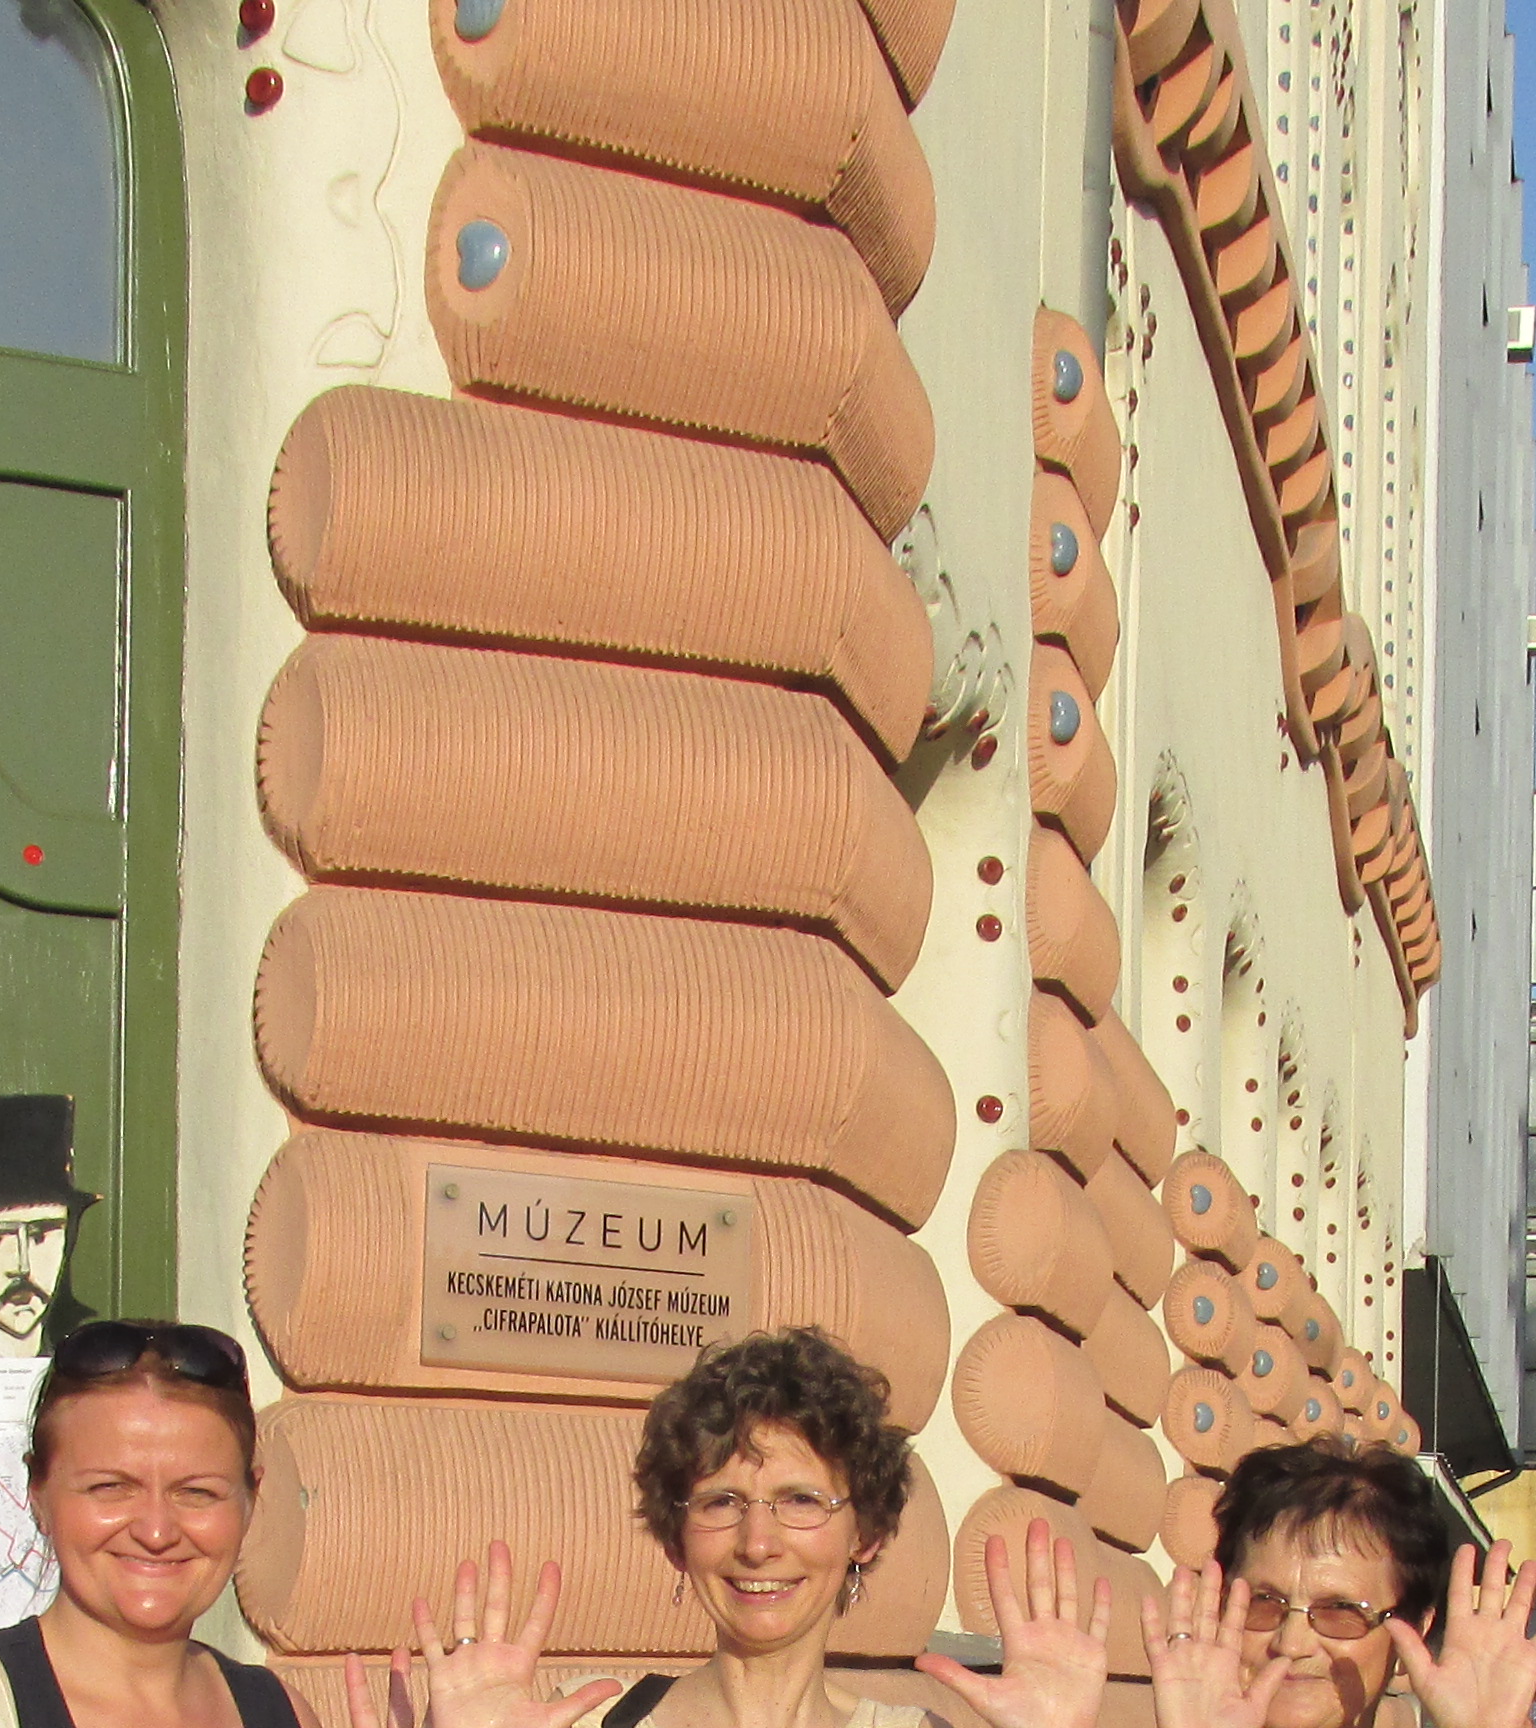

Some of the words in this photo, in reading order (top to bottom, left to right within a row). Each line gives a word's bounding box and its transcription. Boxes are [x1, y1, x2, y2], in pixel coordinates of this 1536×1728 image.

[478, 1198, 707, 1257] MÚZEUM
[447, 1271, 540, 1301] KECSKEMÉTI
[545, 1279, 603, 1307] KATONA
[608, 1280, 662, 1311] JÓZSEF
[667, 1286, 730, 1317] MÚZEUM
[595, 1313, 704, 1347] KIÁLLÍTÓHELYE
